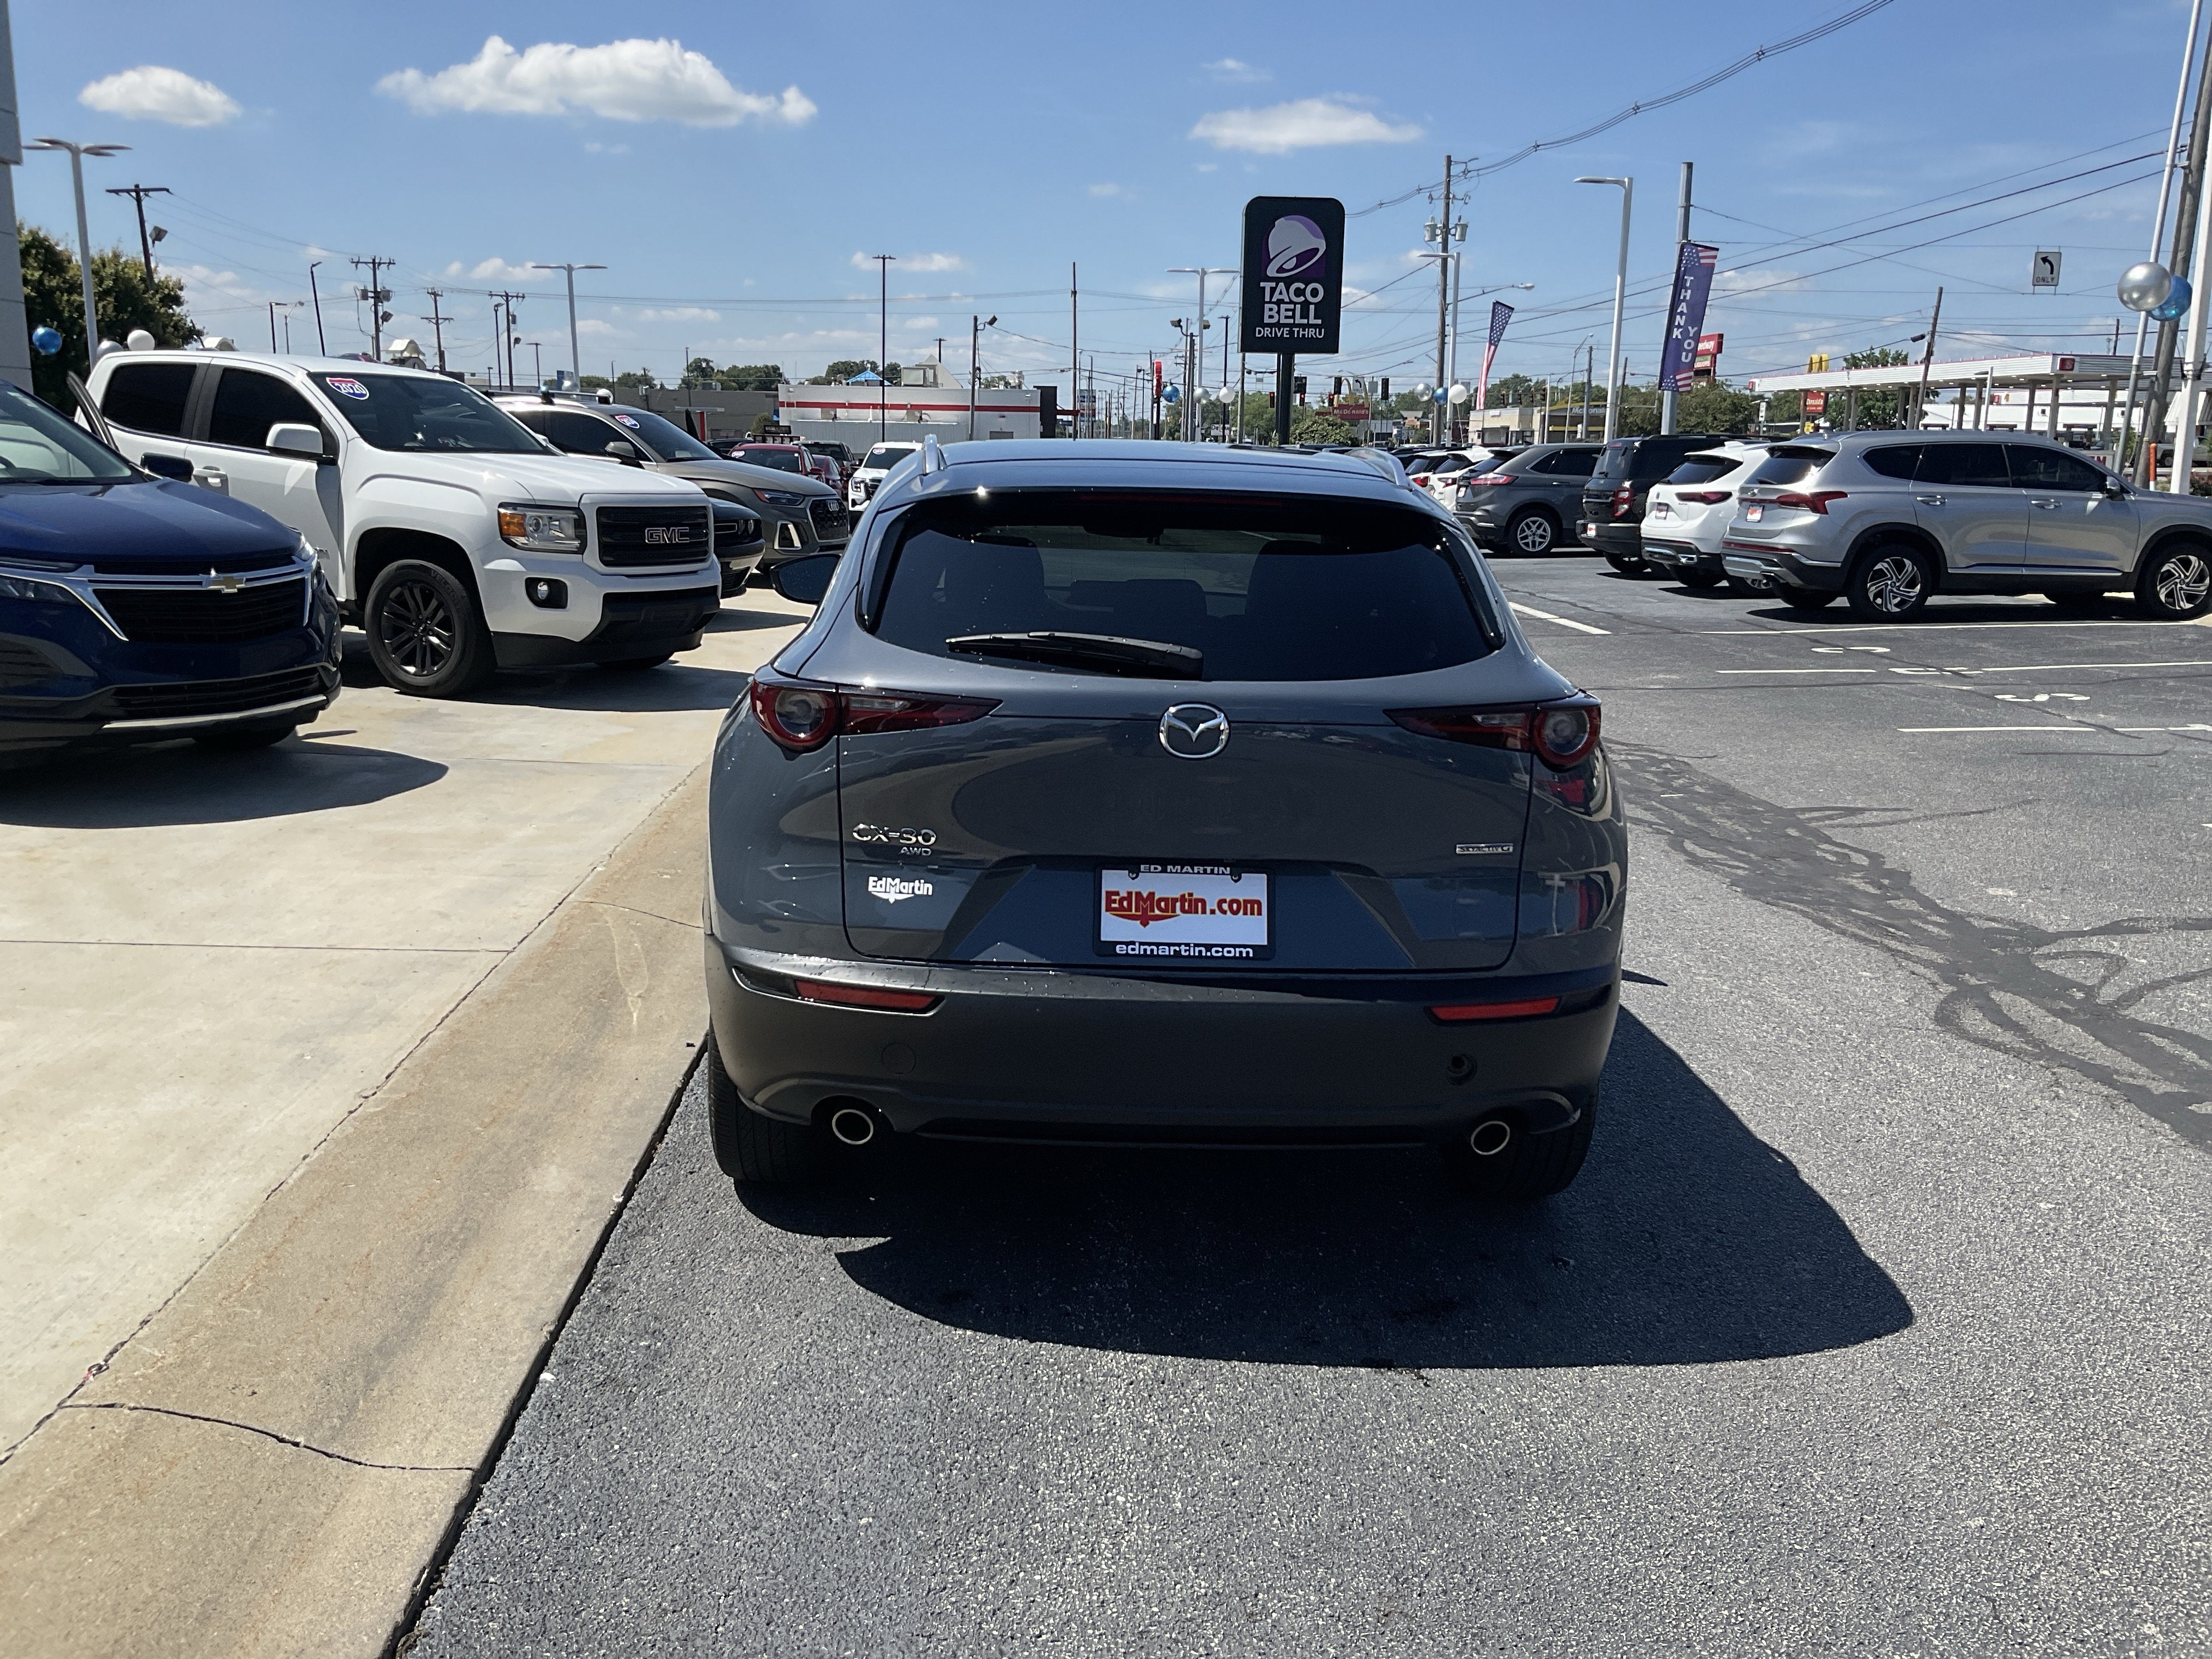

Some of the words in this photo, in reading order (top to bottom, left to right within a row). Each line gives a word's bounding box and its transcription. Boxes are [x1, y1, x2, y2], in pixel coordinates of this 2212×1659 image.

[1260, 282, 1324, 303] TACO
[1263, 304, 1322, 324] BELL
[1673, 276, 1694, 339] THANK
[1256, 327, 1289, 337] DRIVE
[1293, 328, 1324, 338] THRU
[1681, 326, 1698, 363] YOU
[334, 383, 366, 394] 2020
[645, 527, 689, 543] GMC
[853, 823, 936, 845] CX-30
[899, 847, 932, 856] AWD
[1141, 864, 1162, 872] ED
[1167, 865, 1231, 874] MARTIN
[868, 877, 933, 896] EdMartin
[1104, 890, 1262, 917] EdMartin.com
[1116, 942, 1253, 957] edmartin.com
